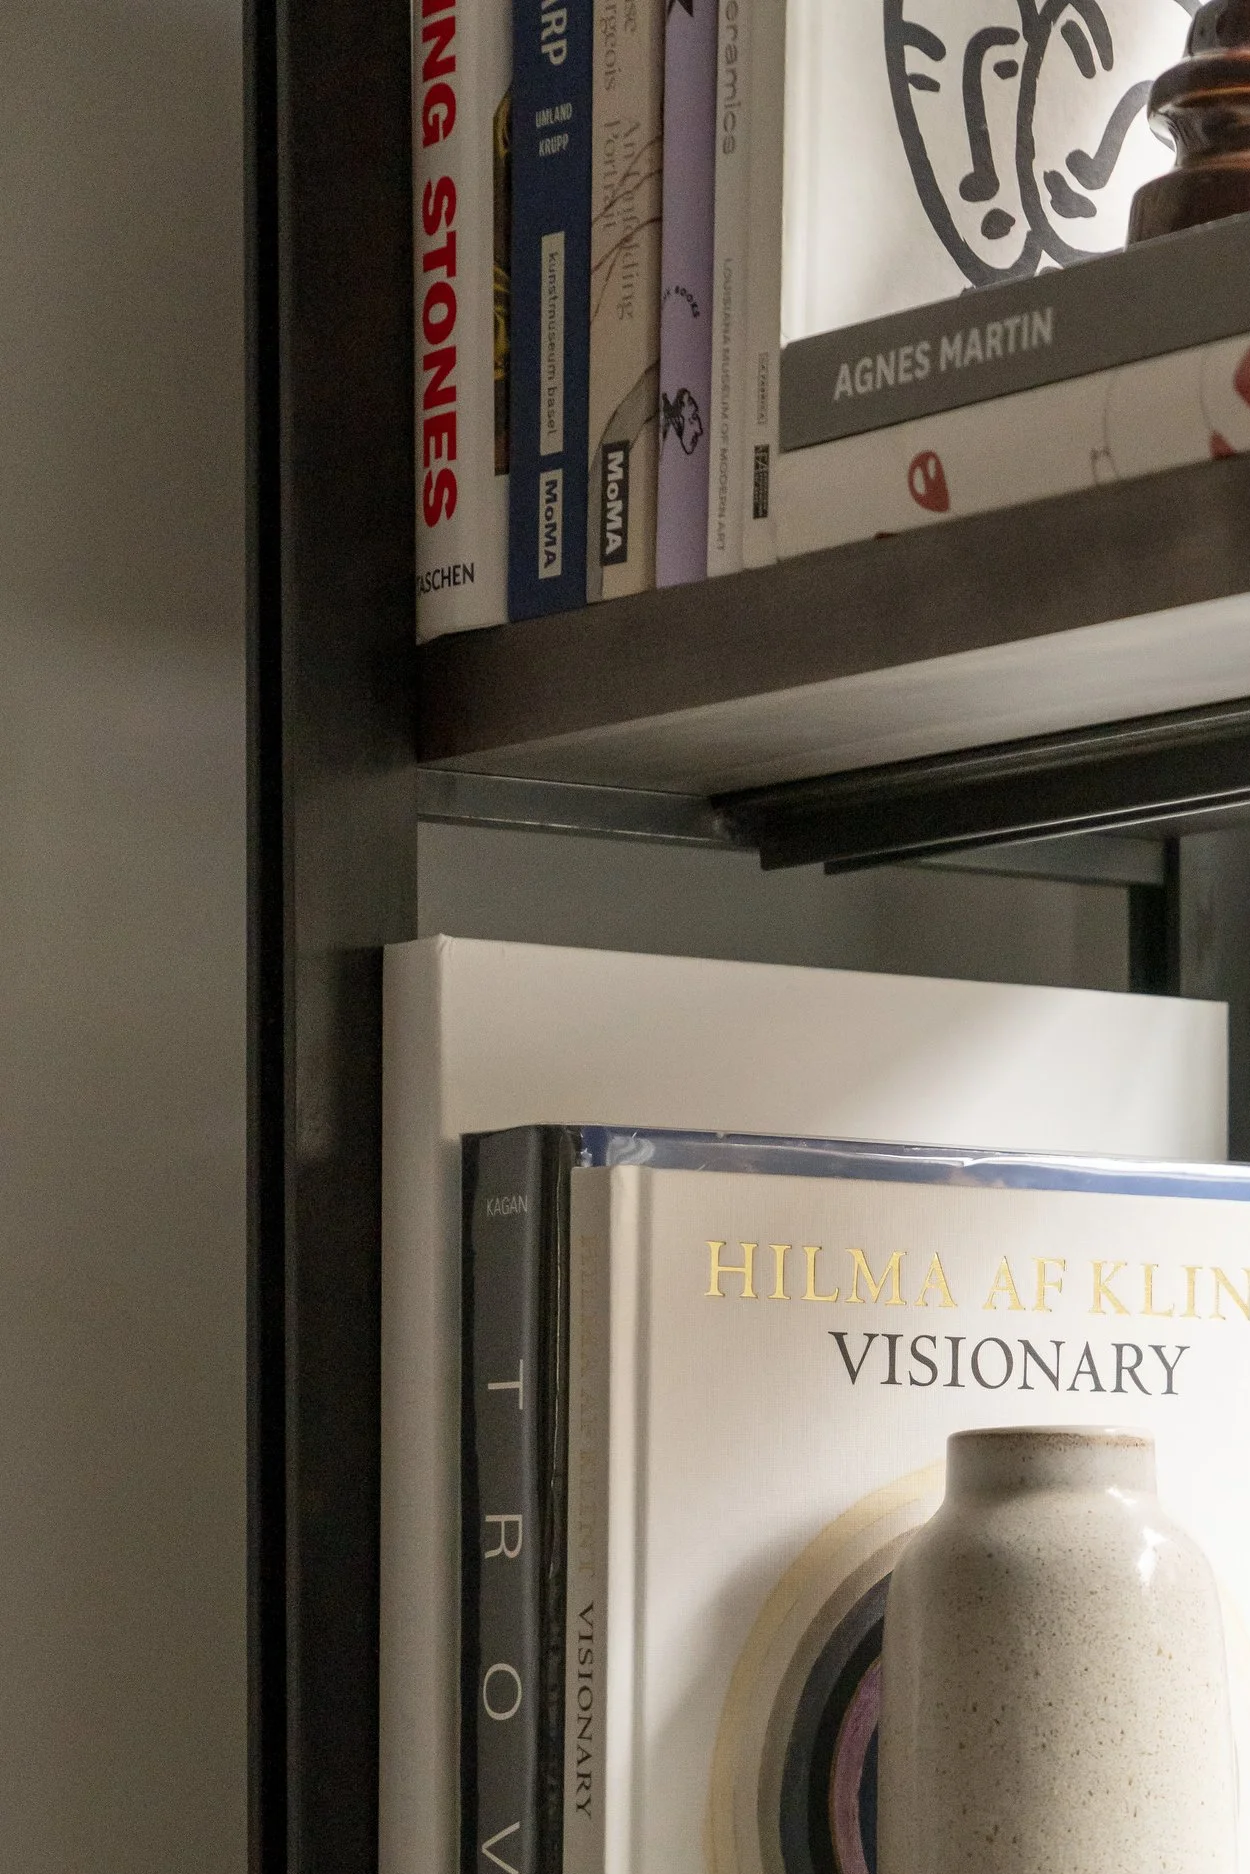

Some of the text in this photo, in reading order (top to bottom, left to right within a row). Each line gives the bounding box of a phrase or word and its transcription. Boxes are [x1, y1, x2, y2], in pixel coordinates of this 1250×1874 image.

[535, 102, 573, 129] UMLAND
[538, 133, 570, 157] KRUPP
[422, 176, 458, 528] STONES
[546, 251, 560, 436] kunstmuseum basel
[834, 342, 932, 402] AGNES
[940, 306, 1055, 374] MARTIN
[719, 349, 732, 419] MUSEUM
[719, 422, 730, 443] OF
[605, 450, 625, 556] MoMA
[717, 448, 729, 518] MODERN
[543, 479, 558, 569] MoMA
[486, 1194, 528, 1217] KAGAN
[703, 1239, 958, 1309] HILMA
[986, 1255, 1068, 1312] AF
[827, 1330, 1191, 1398] VISIONARY
[574, 1600, 595, 1820] VISIONARY
